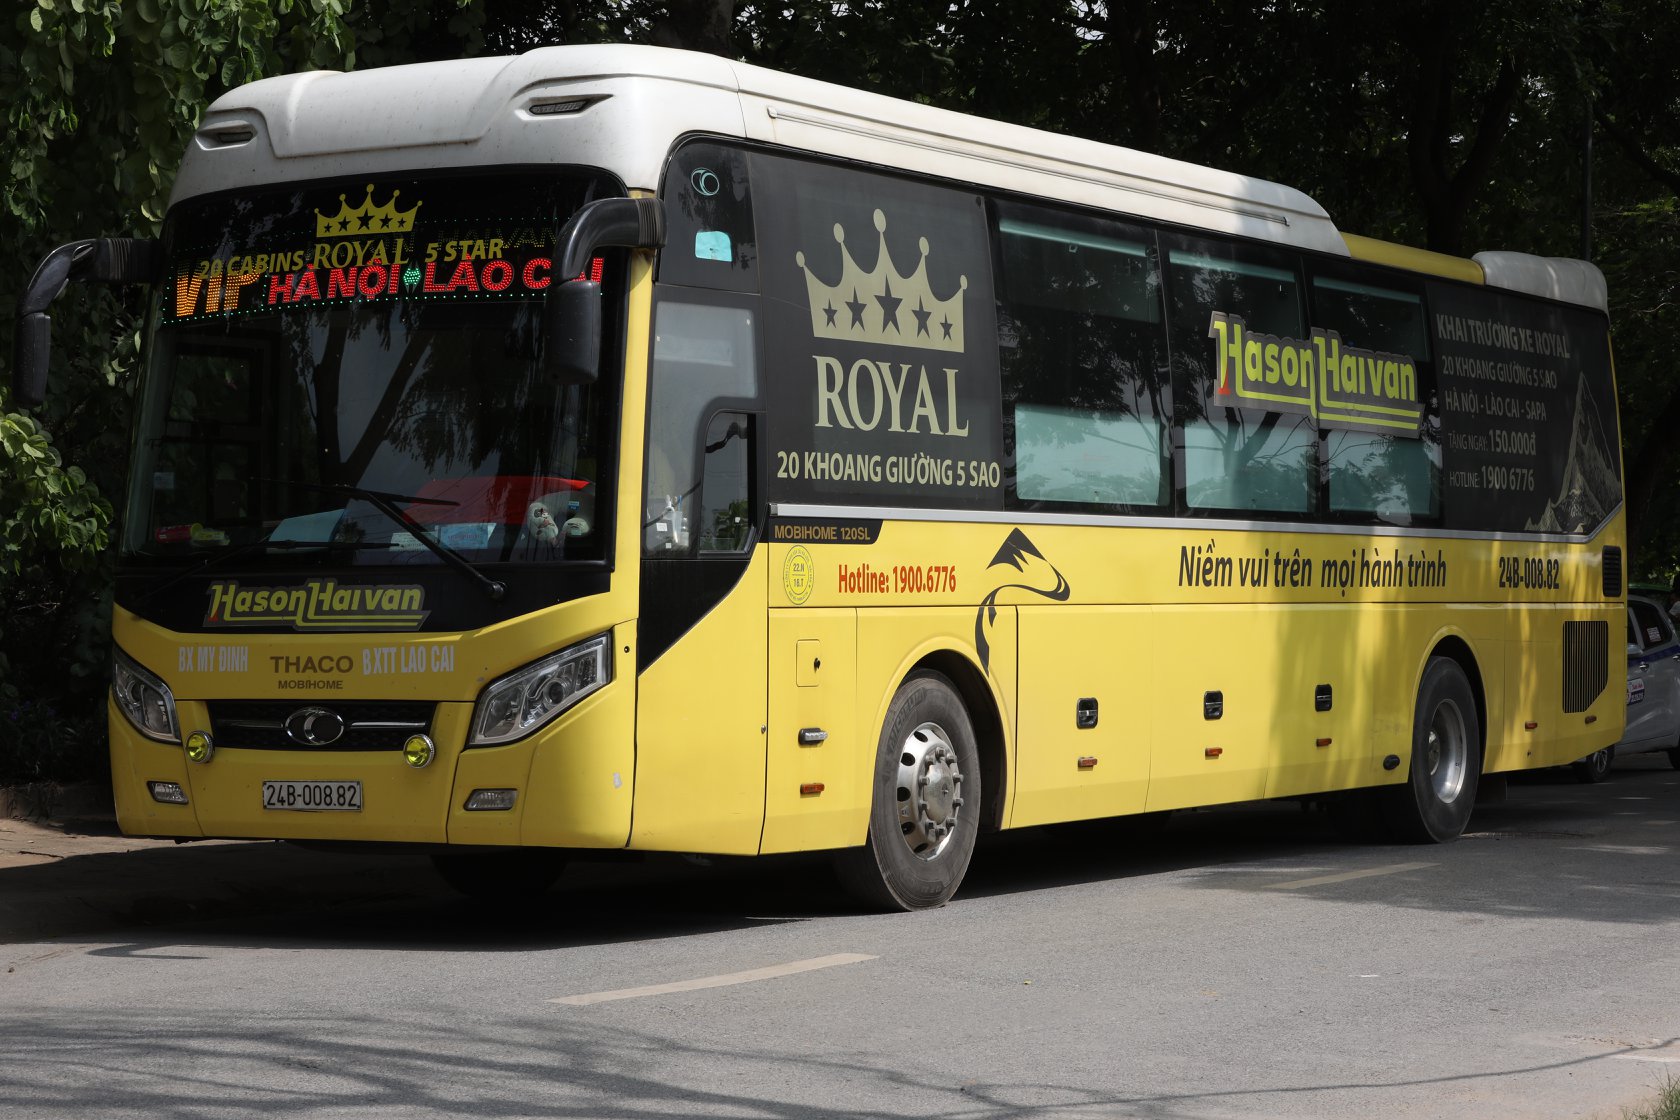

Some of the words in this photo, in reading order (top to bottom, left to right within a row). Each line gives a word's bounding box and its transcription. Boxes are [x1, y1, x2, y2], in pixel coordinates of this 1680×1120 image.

[200, 258, 223, 280] 20
[226, 249, 305, 276] CABINS
[313, 237, 410, 270] ROYAL
[424, 242, 439, 263] 5
[443, 238, 504, 262] STAR
[176, 266, 261, 317] VIP
[522, 256, 606, 291] CI
[1435, 313, 1468, 342] KHAI
[1468, 318, 1519, 352] TRƯƠNG
[1518, 327, 1535, 353] XE
[1441, 355, 1455, 376] 20
[1455, 356, 1496, 381] KHOANG
[1496, 360, 1533, 387] GIƯỜNG
[1532, 368, 1539, 388] 5
[1539, 368, 1558, 390] SAO
[811, 354, 970, 438] ROYAL
[1445, 387, 1460, 412] HÀ
[1461, 388, 1479, 419] NỘI
[1484, 391, 1504, 417] LÀO
[1504, 398, 1520, 419] CAI
[1525, 399, 1548, 422] SAPA
[1488, 428, 1537, 456] 150.000đ
[776, 450, 800, 479] 20
[804, 451, 882, 482] KHOANG
[885, 452, 953, 486] GIƯỜNG
[956, 461, 967, 486] 5
[969, 461, 1001, 488] SAO
[1480, 464, 1508, 490] 1900
[1508, 466, 1536, 492] 6776
[774, 525, 838, 540] MOBIHOME
[840, 526, 871, 541] 120SL
[838, 563, 890, 595] Hotline:
[891, 564, 957, 594] 1900.6776
[1178, 538, 1234, 588] Niềm
[1238, 548, 1269, 588] vui
[1273, 548, 1313, 588] trên
[1320, 548, 1357, 598] mọi
[1360, 547, 1404, 588] hành
[1407, 550, 1447, 588] trình
[1498, 556, 1561, 590] 24B-008.82
[178, 646, 195, 673] BX
[197, 646, 216, 673] MY
[270, 655, 354, 674] THACO
[400, 646, 427, 673] LAO
[430, 645, 456, 673] CAI
[277, 679, 344, 690] MOBIHOME
[266, 784, 357, 808] 24B-008.82
